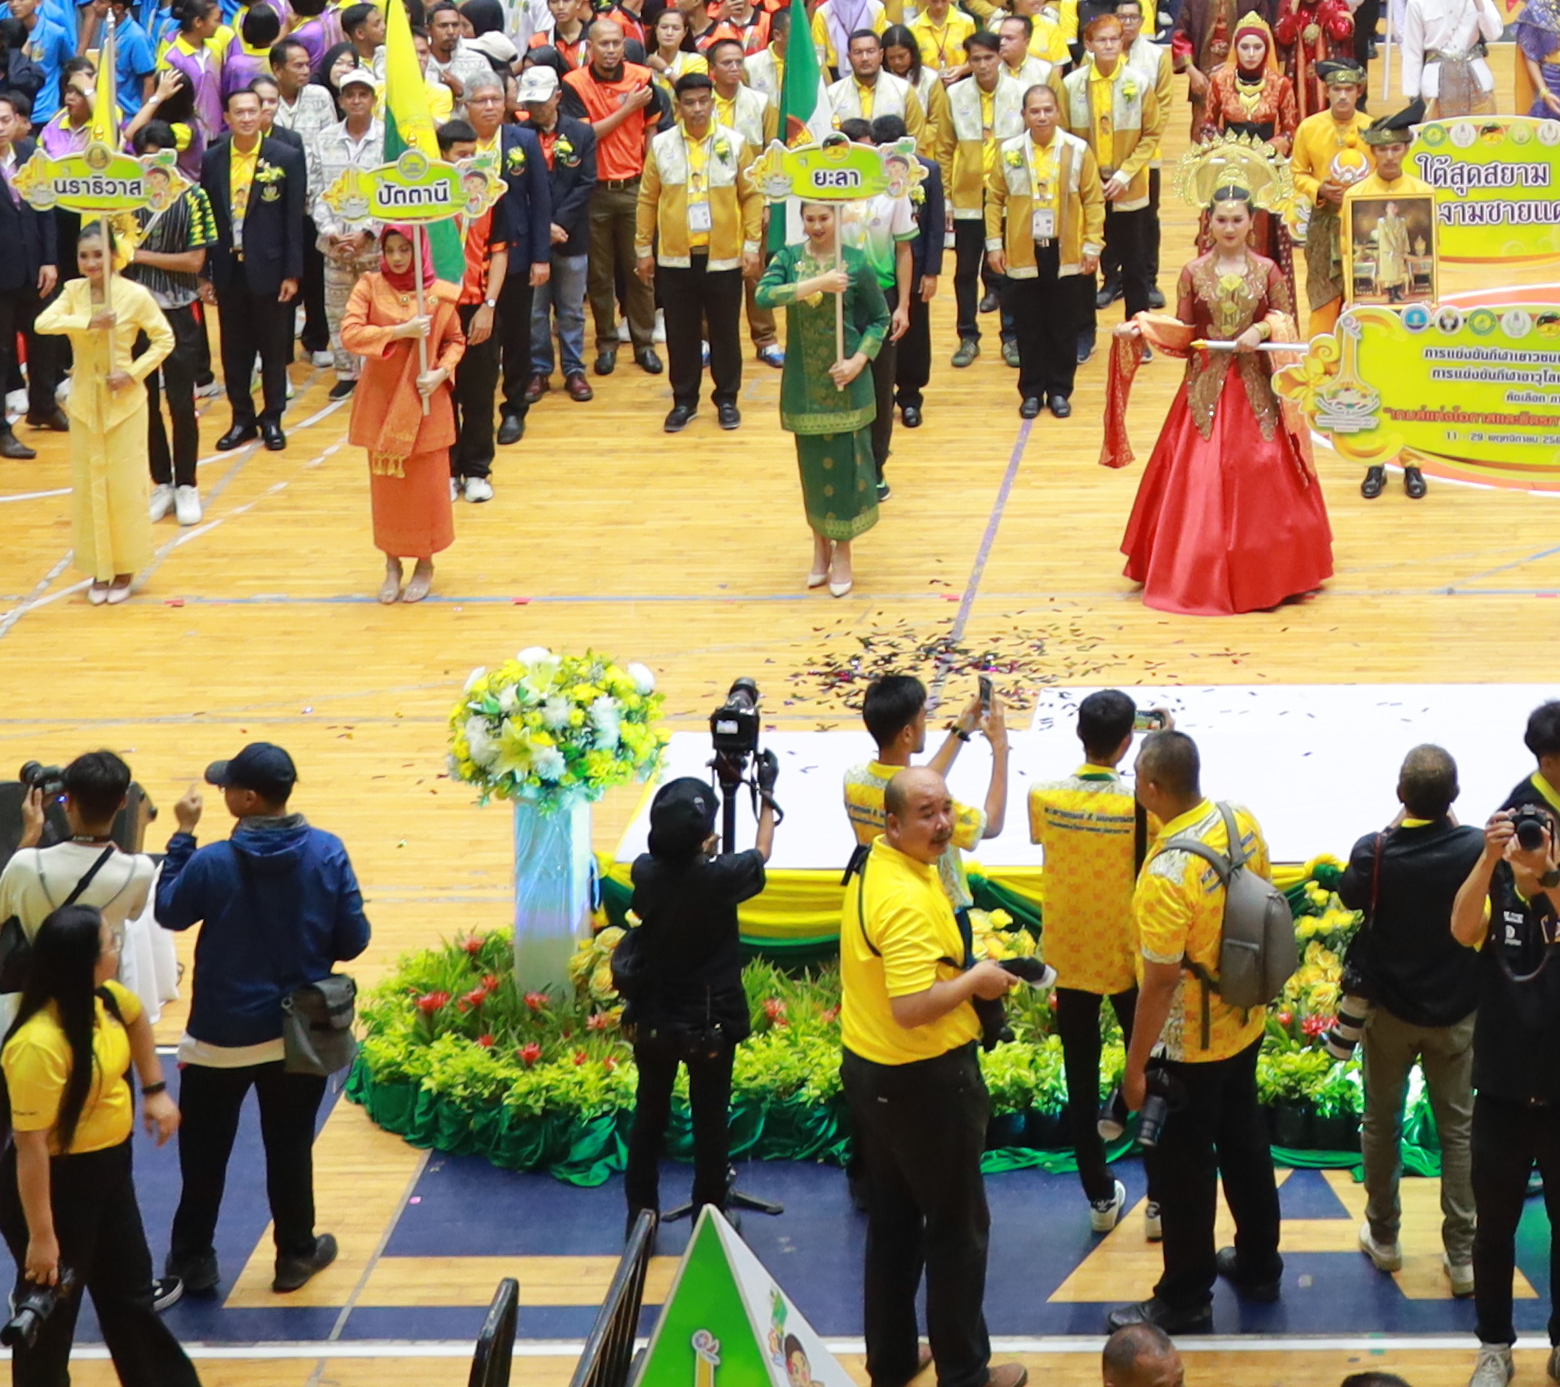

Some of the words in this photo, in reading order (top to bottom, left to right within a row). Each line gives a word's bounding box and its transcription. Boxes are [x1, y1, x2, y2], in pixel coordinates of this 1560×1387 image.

[814, 169, 859, 187] ยะลา
[1415, 153, 1550, 197] ใต้สุดสยาม
[53, 176, 142, 196] นราธิวาส
[378, 181, 449, 205] ปัตตานี
[1506, 391, 1546, 403] คัดเลือก
